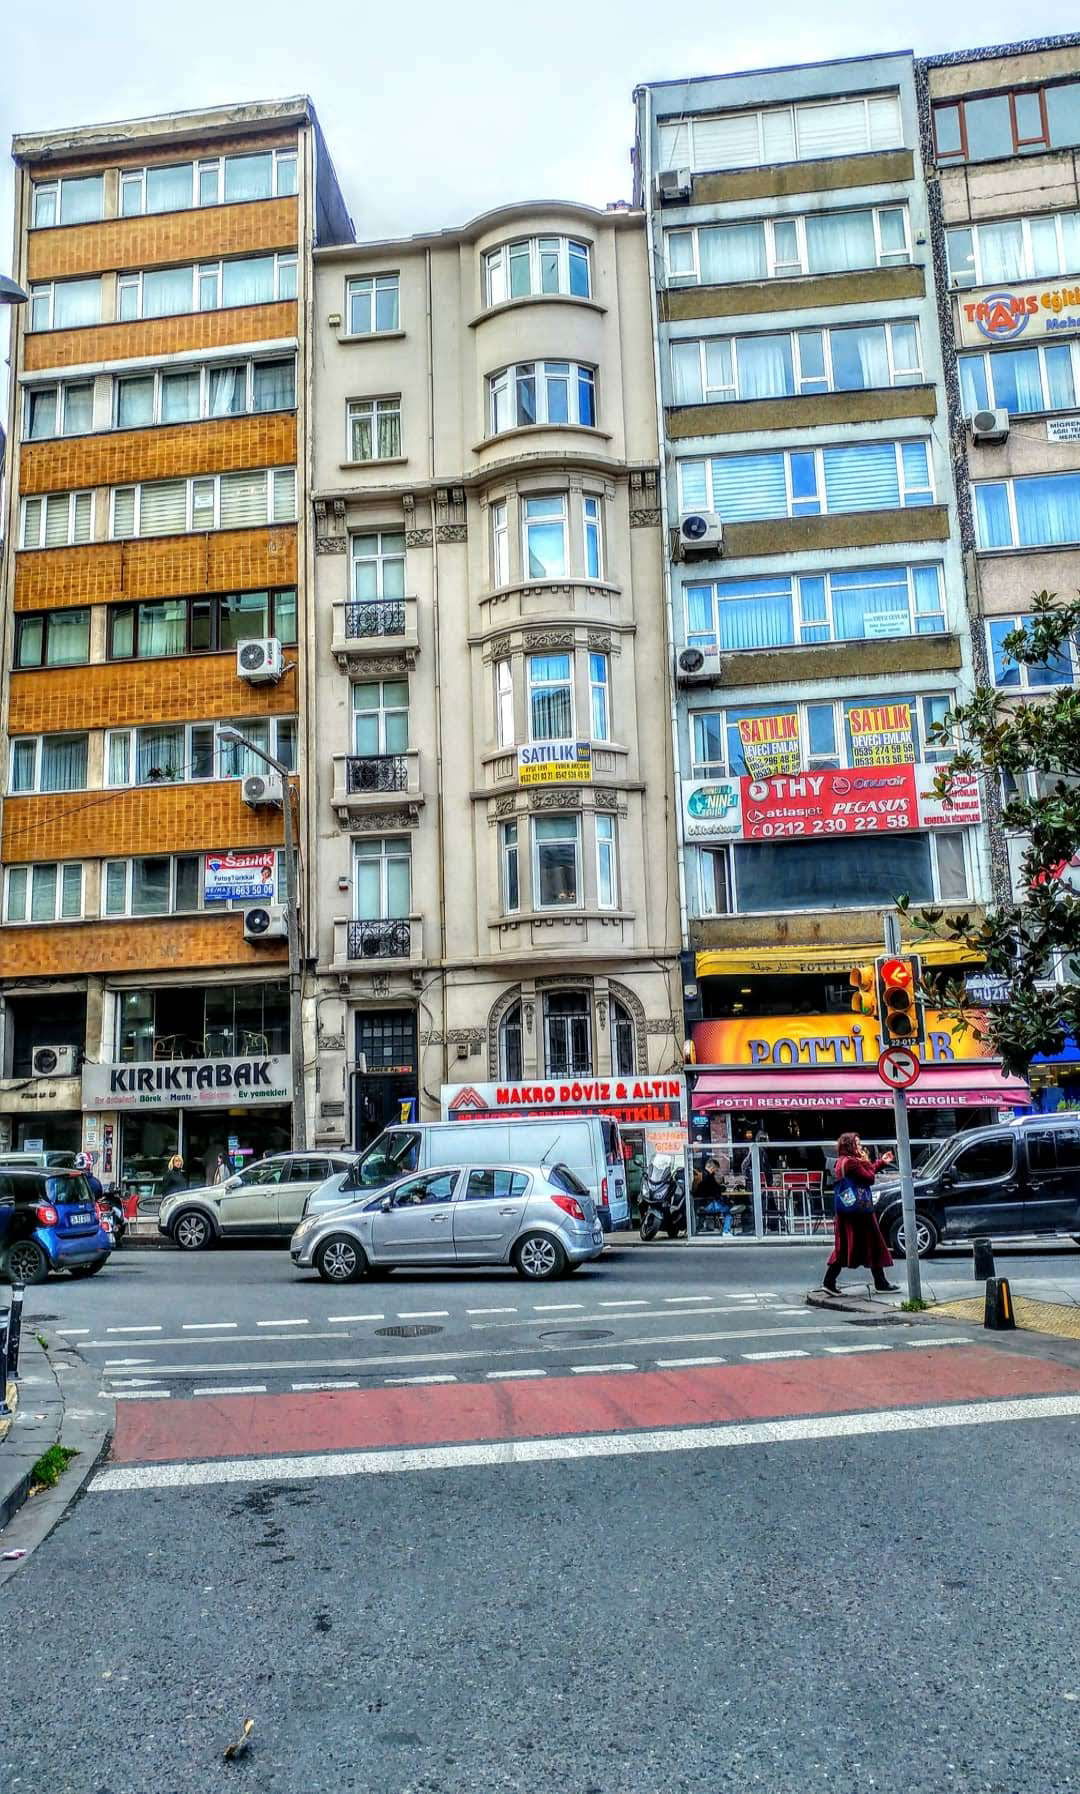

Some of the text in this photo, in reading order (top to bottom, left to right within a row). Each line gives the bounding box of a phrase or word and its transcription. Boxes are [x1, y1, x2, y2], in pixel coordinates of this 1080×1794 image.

[964, 296, 1038, 332] TRANS
[740, 716, 798, 742] SATILIK
[850, 705, 910, 732] SATILIK
[883, 732, 912, 744] EMLAK
[522, 744, 574, 764] SATILIK
[771, 776, 824, 798] THY
[766, 798, 910, 818] atlasjet PEGASUS
[762, 814, 909, 836] 0212 230 22 58
[225, 854, 272, 866] Satılık
[236, 886, 250, 895] 663
[748, 1024, 864, 1064] POTTİ
[110, 1062, 272, 1092] KIRIKTABAK
[250, 1088, 287, 1099] yemekleri
[496, 1081, 680, 1104] MAKRO DÖVİZ & ALTIN
[716, 1096, 966, 1107] POTTİ RESTAURANT CAFE NARGİLE
